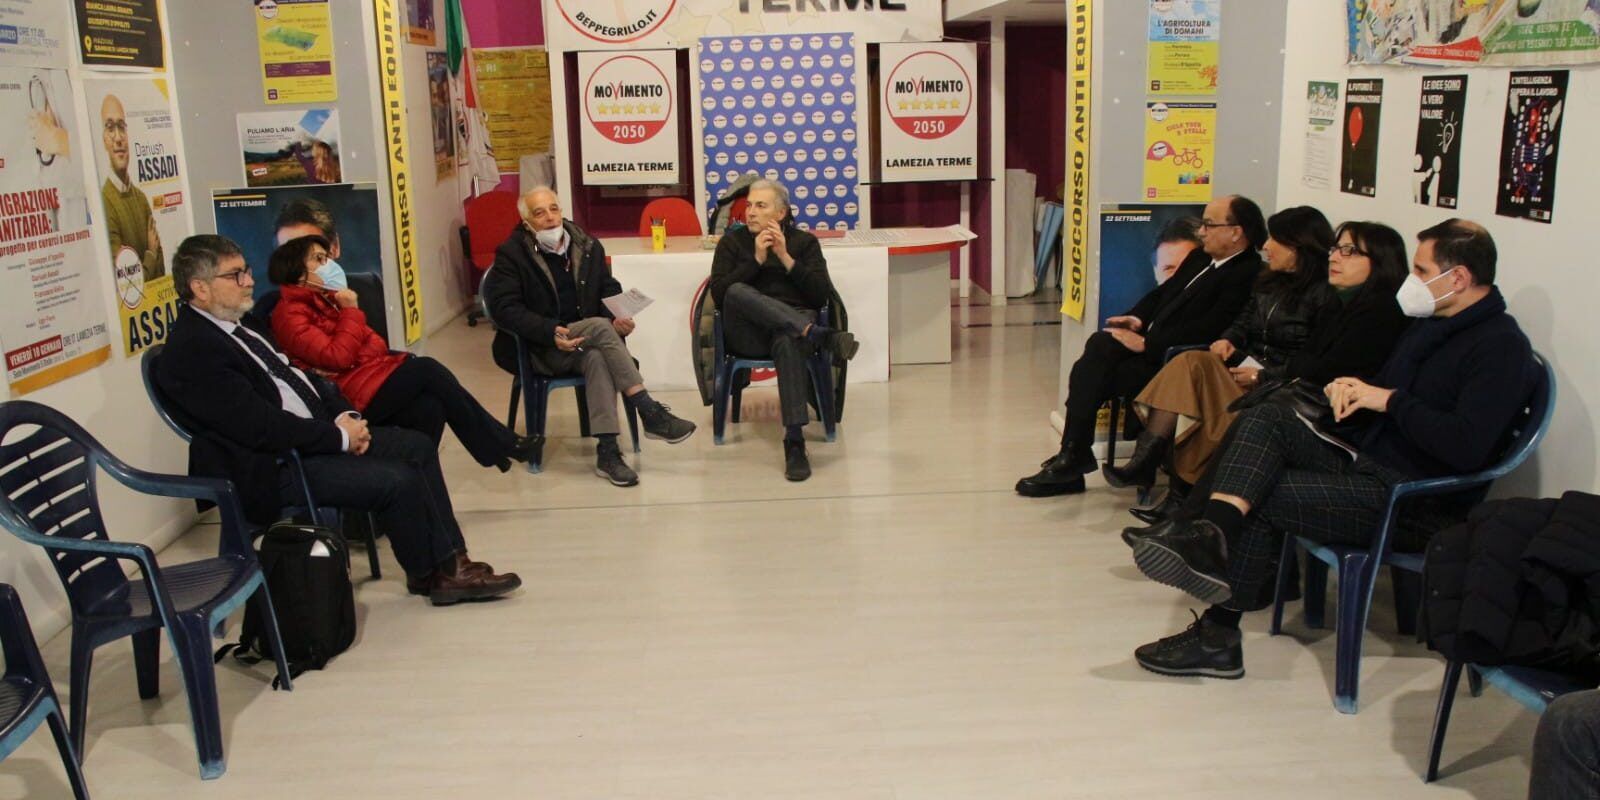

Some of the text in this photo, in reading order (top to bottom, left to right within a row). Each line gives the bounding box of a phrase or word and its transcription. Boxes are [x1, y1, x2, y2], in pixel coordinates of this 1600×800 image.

[575, 9, 657, 36] BEPPEGRILLO.IT
[594, 80, 663, 100] MOVIMENTO
[895, 75, 963, 96] MOVIMENTO
[1423, 79, 1461, 91] LE IDEE SONO
[1422, 95, 1443, 104] IL VERO
[1421, 109, 1443, 119] VALORE
[390, 100, 404, 163] ANTI
[613, 124, 646, 139] 2050
[913, 120, 945, 134] 2050
[135, 142, 165, 157] Dariush
[1072, 0, 1086, 303] SOCCORSO ANTI EQUI
[137, 154, 179, 182] ASSADI
[587, 162, 673, 172] LAMEZIA TERME
[886, 157, 972, 168] LAMEZIA TERME
[0, 187, 60, 217] IGRAZIONE
[229, 200, 266, 208] SETTEMBRE
[396, 172, 419, 327] SOCCORSO
[129, 300, 180, 354] ASSA
